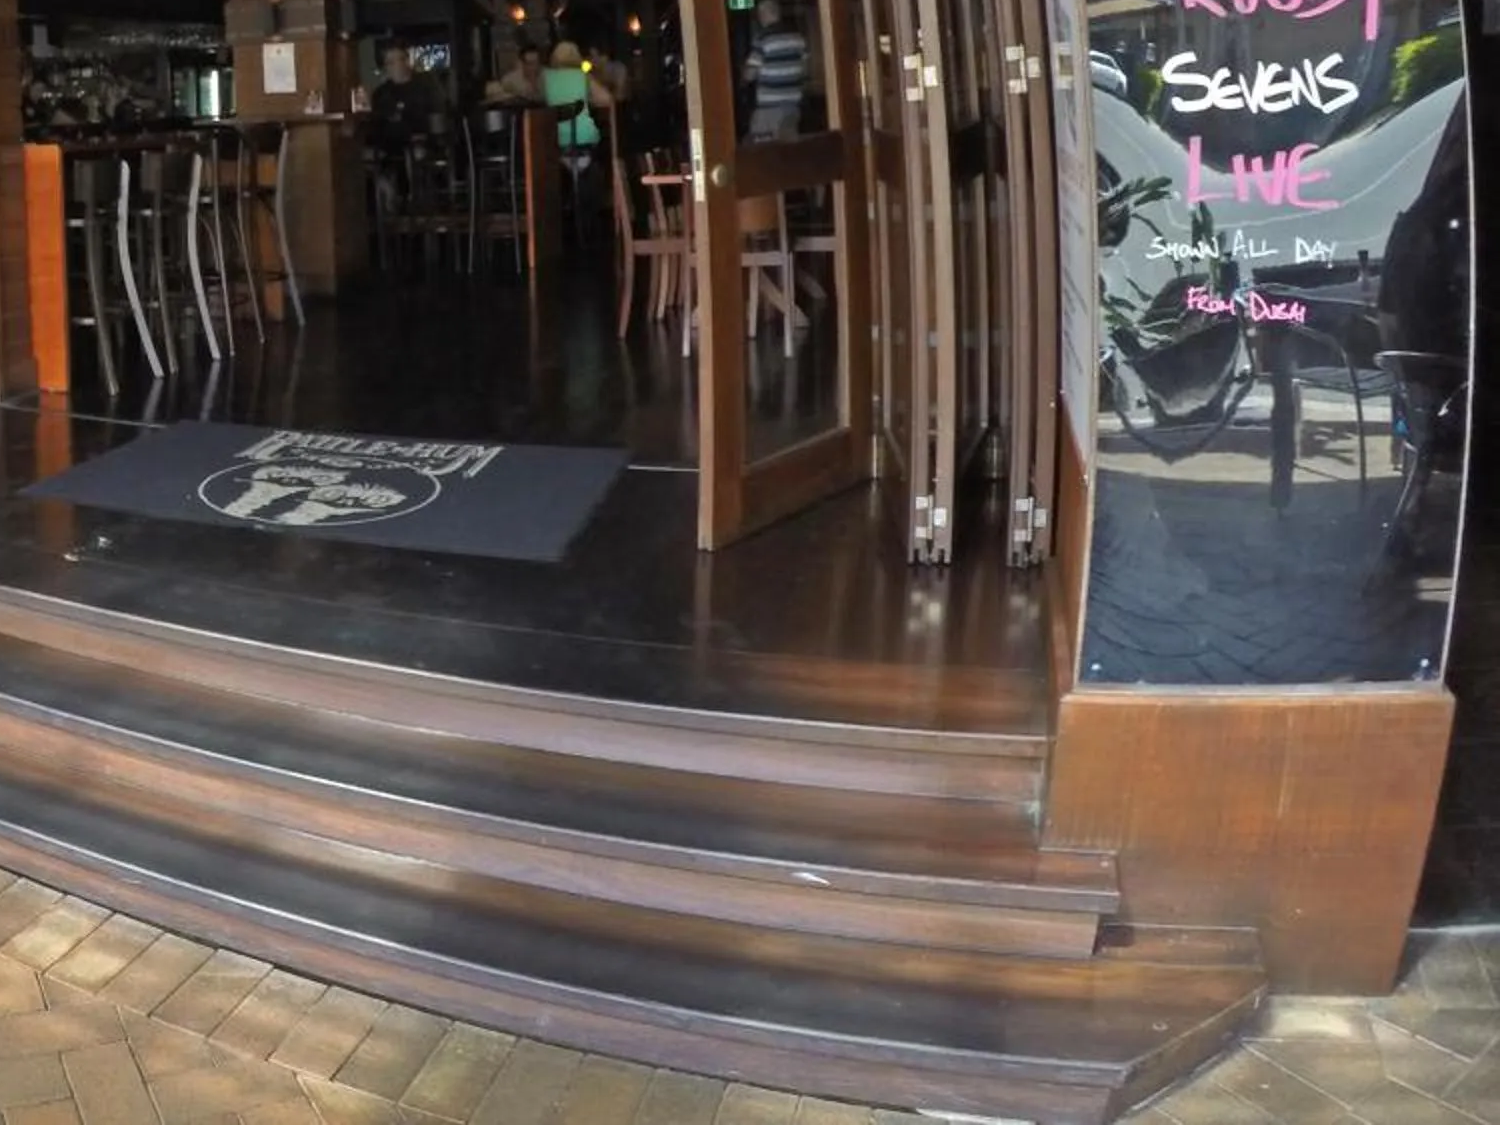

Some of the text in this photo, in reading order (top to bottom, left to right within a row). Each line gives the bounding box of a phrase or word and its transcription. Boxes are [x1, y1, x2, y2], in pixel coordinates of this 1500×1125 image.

[1160, 52, 1361, 115] SEVENS
[1186, 134, 1347, 211] LIVE
[1145, 228, 1338, 270] SHOWN ALL DAY
[1185, 285, 1237, 317] FROM
